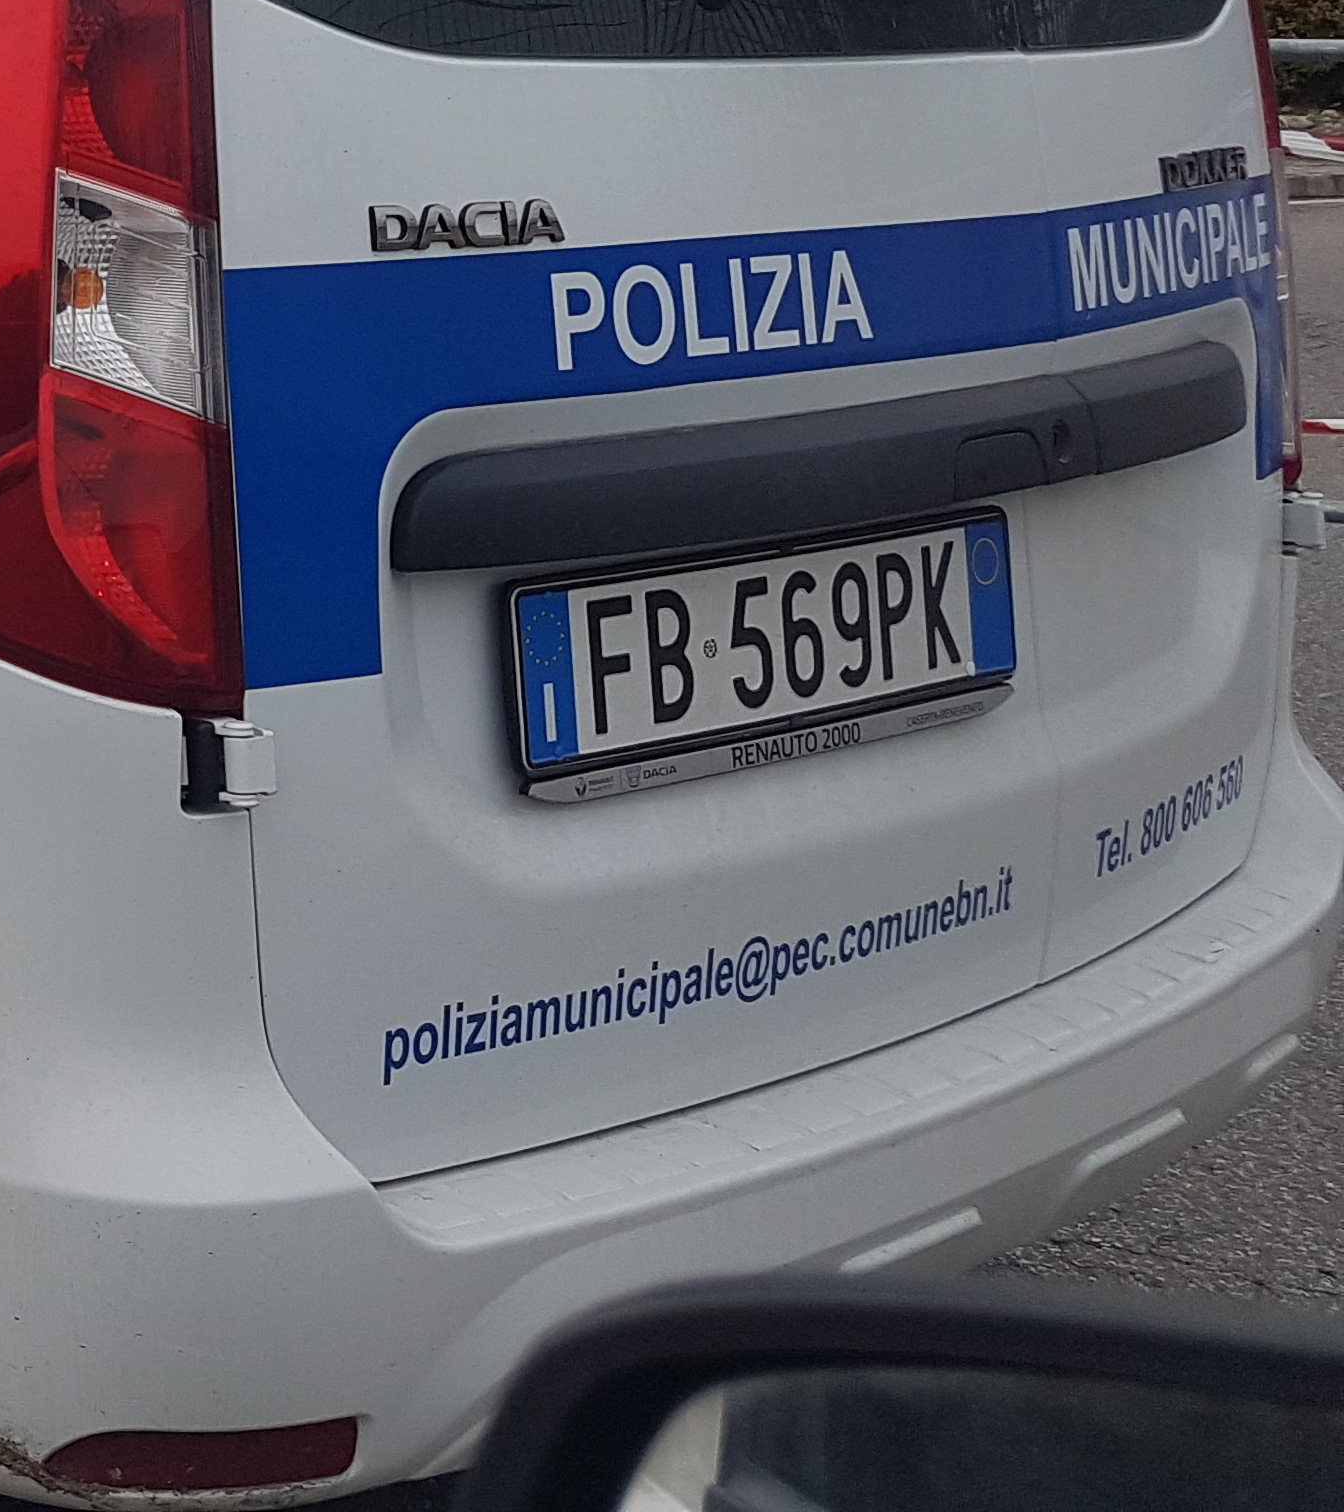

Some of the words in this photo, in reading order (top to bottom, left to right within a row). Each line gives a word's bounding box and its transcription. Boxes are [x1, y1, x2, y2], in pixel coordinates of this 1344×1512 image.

[368, 198, 565, 252] DACIA
[1157, 146, 1248, 192] DOKKER
[549, 249, 875, 372] POLIZIA
[1065, 192, 1272, 312] MUNICIPALE
[584, 587, 696, 736] FB
[730, 538, 964, 710] 569PK
[643, 764, 678, 780] DACIA
[731, 732, 817, 768] RENAUTO
[822, 722, 861, 749] 2000
[1095, 820, 1132, 877] Tel.
[1141, 795, 1177, 856] 800
[1181, 773, 1214, 832] 606
[1216, 754, 1244, 811] 560
[382, 864, 1014, 1086] poliziamunicipale@pec.comunebn.it
